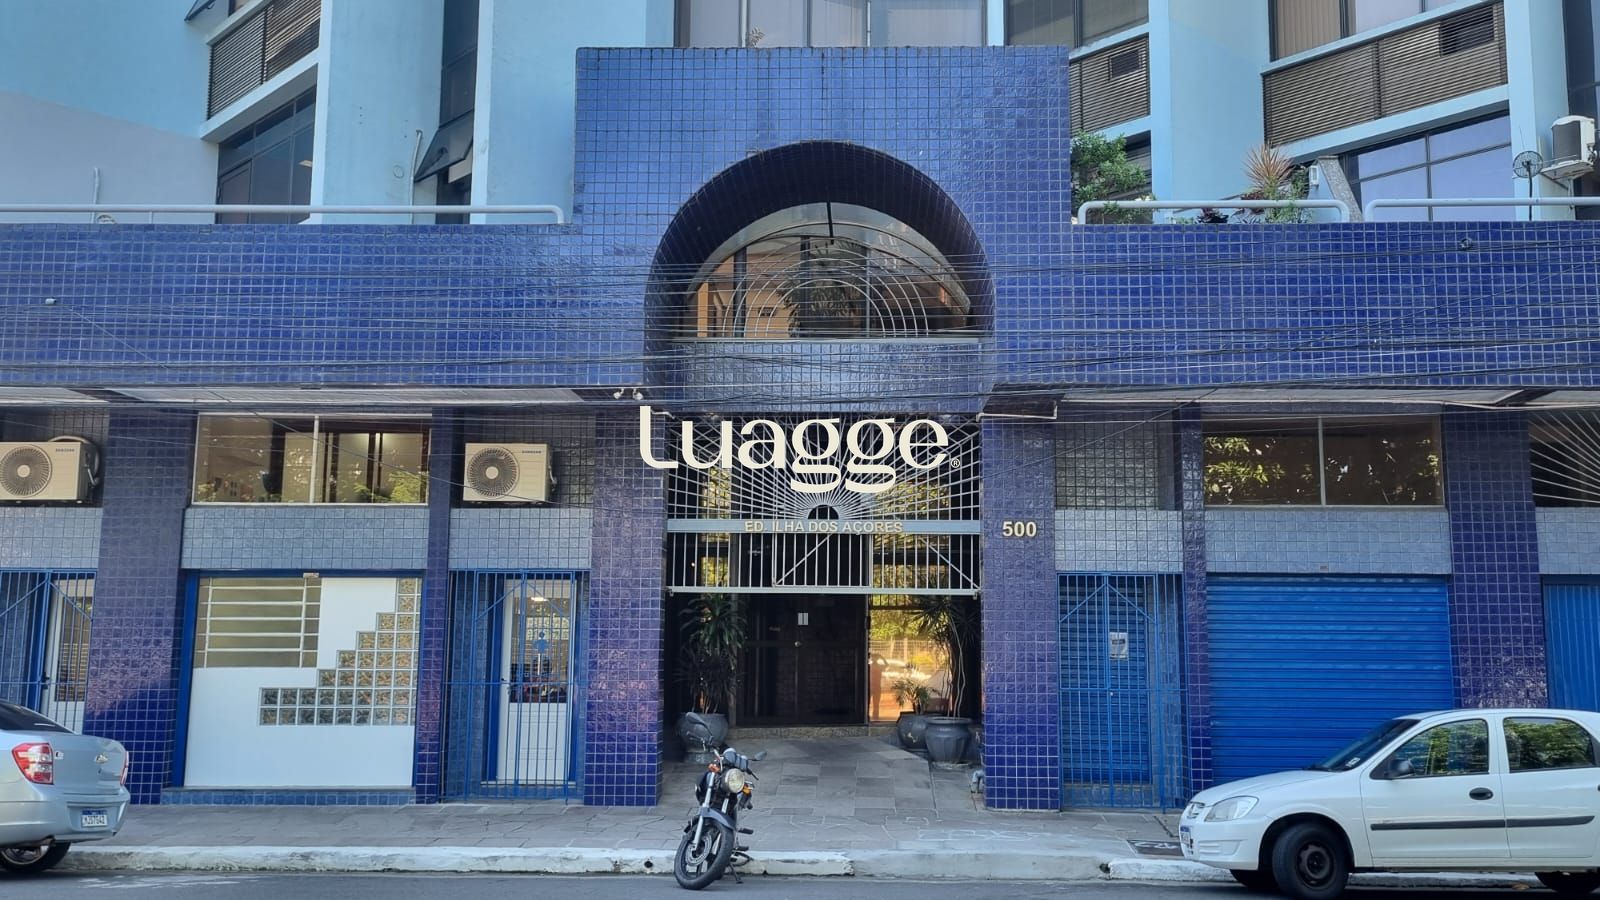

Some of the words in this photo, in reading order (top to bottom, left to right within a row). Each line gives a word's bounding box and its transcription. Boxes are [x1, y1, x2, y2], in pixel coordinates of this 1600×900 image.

[745, 521, 768, 532] ED.
[772, 521, 805, 532] ILHA
[808, 521, 838, 532] DOS
[842, 521, 903, 535] AÇORES
[1002, 521, 1037, 537] 500
